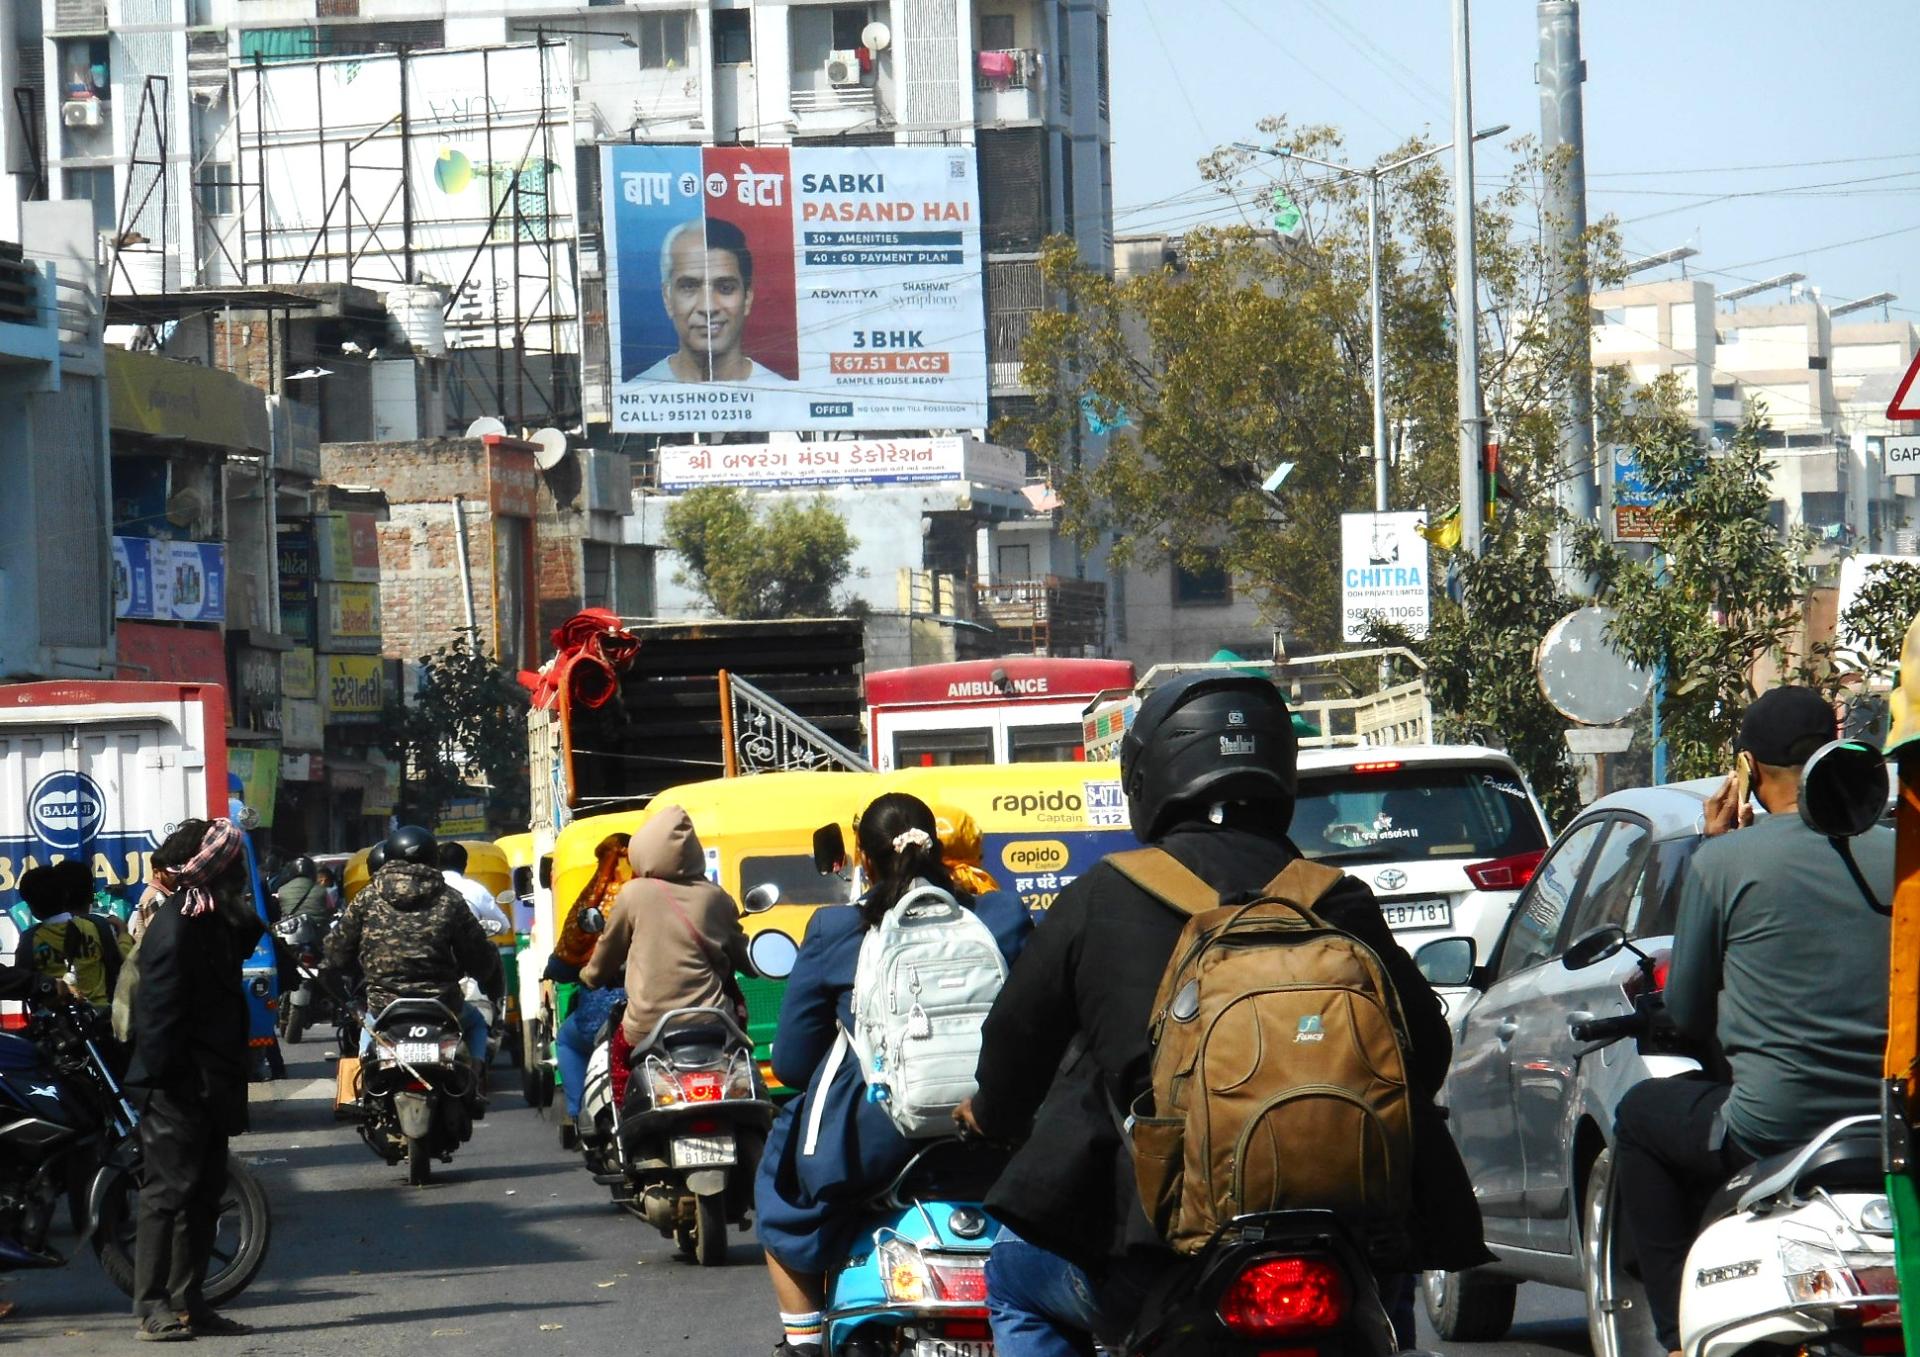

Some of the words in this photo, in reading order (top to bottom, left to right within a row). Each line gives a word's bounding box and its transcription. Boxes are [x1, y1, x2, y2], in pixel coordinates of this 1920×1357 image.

[428, 95, 510, 125] AURA
[620, 172, 672, 206] बाप
[682, 176, 696, 193] हो
[709, 180, 724, 193] या
[733, 163, 784, 206] बेटा
[802, 173, 884, 193] SABKI
[802, 202, 915, 222] PASAND
[923, 202, 969, 222] HAI
[812, 234, 833, 244] 30+
[837, 234, 899, 244] AMENITIES
[813, 254, 828, 263] 40
[841, 254, 855, 263] 60
[860, 254, 913, 263] PAYMENT
[918, 254, 949, 262] PLAN
[811, 290, 879, 299] ADVAITYA
[902, 282, 950, 292] SHASHVAT
[892, 292, 960, 309] symphony
[853, 331, 866, 348] 3
[872, 330, 925, 348] BHK
[834, 356, 887, 371] ₹67.51
[836, 376, 874, 385] SAMPLE
[877, 376, 909, 385] HOUSE
[912, 376, 944, 385] READY
[619, 394, 645, 405] NR.
[650, 392, 755, 404] VAISHNODEVI
[620, 411, 664, 422] CALL:
[668, 410, 706, 421] 95121
[711, 409, 753, 420] 02318
[815, 405, 848, 415] OFFER
[688, 450, 711, 469] શ્રી
[723, 449, 787, 468] બજરંગ
[799, 447, 839, 465] મંડપ
[850, 443, 933, 464] ડેકોરેશન
[1346, 567, 1421, 588] CHITRA
[1390, 606, 1424, 617] 11065
[332, 661, 381, 707] સ્ટેશનરી
[948, 678, 1048, 697] AMBULANCE
[992, 790, 1082, 816] rapido
[42, 806, 91, 816] BALAJI
[1037, 813, 1083, 823] Captain
[1092, 814, 1123, 824] 112
[1011, 848, 1060, 866] rapido
[1016, 878, 1033, 893] हर
[409, 1026, 428, 1038] 10
